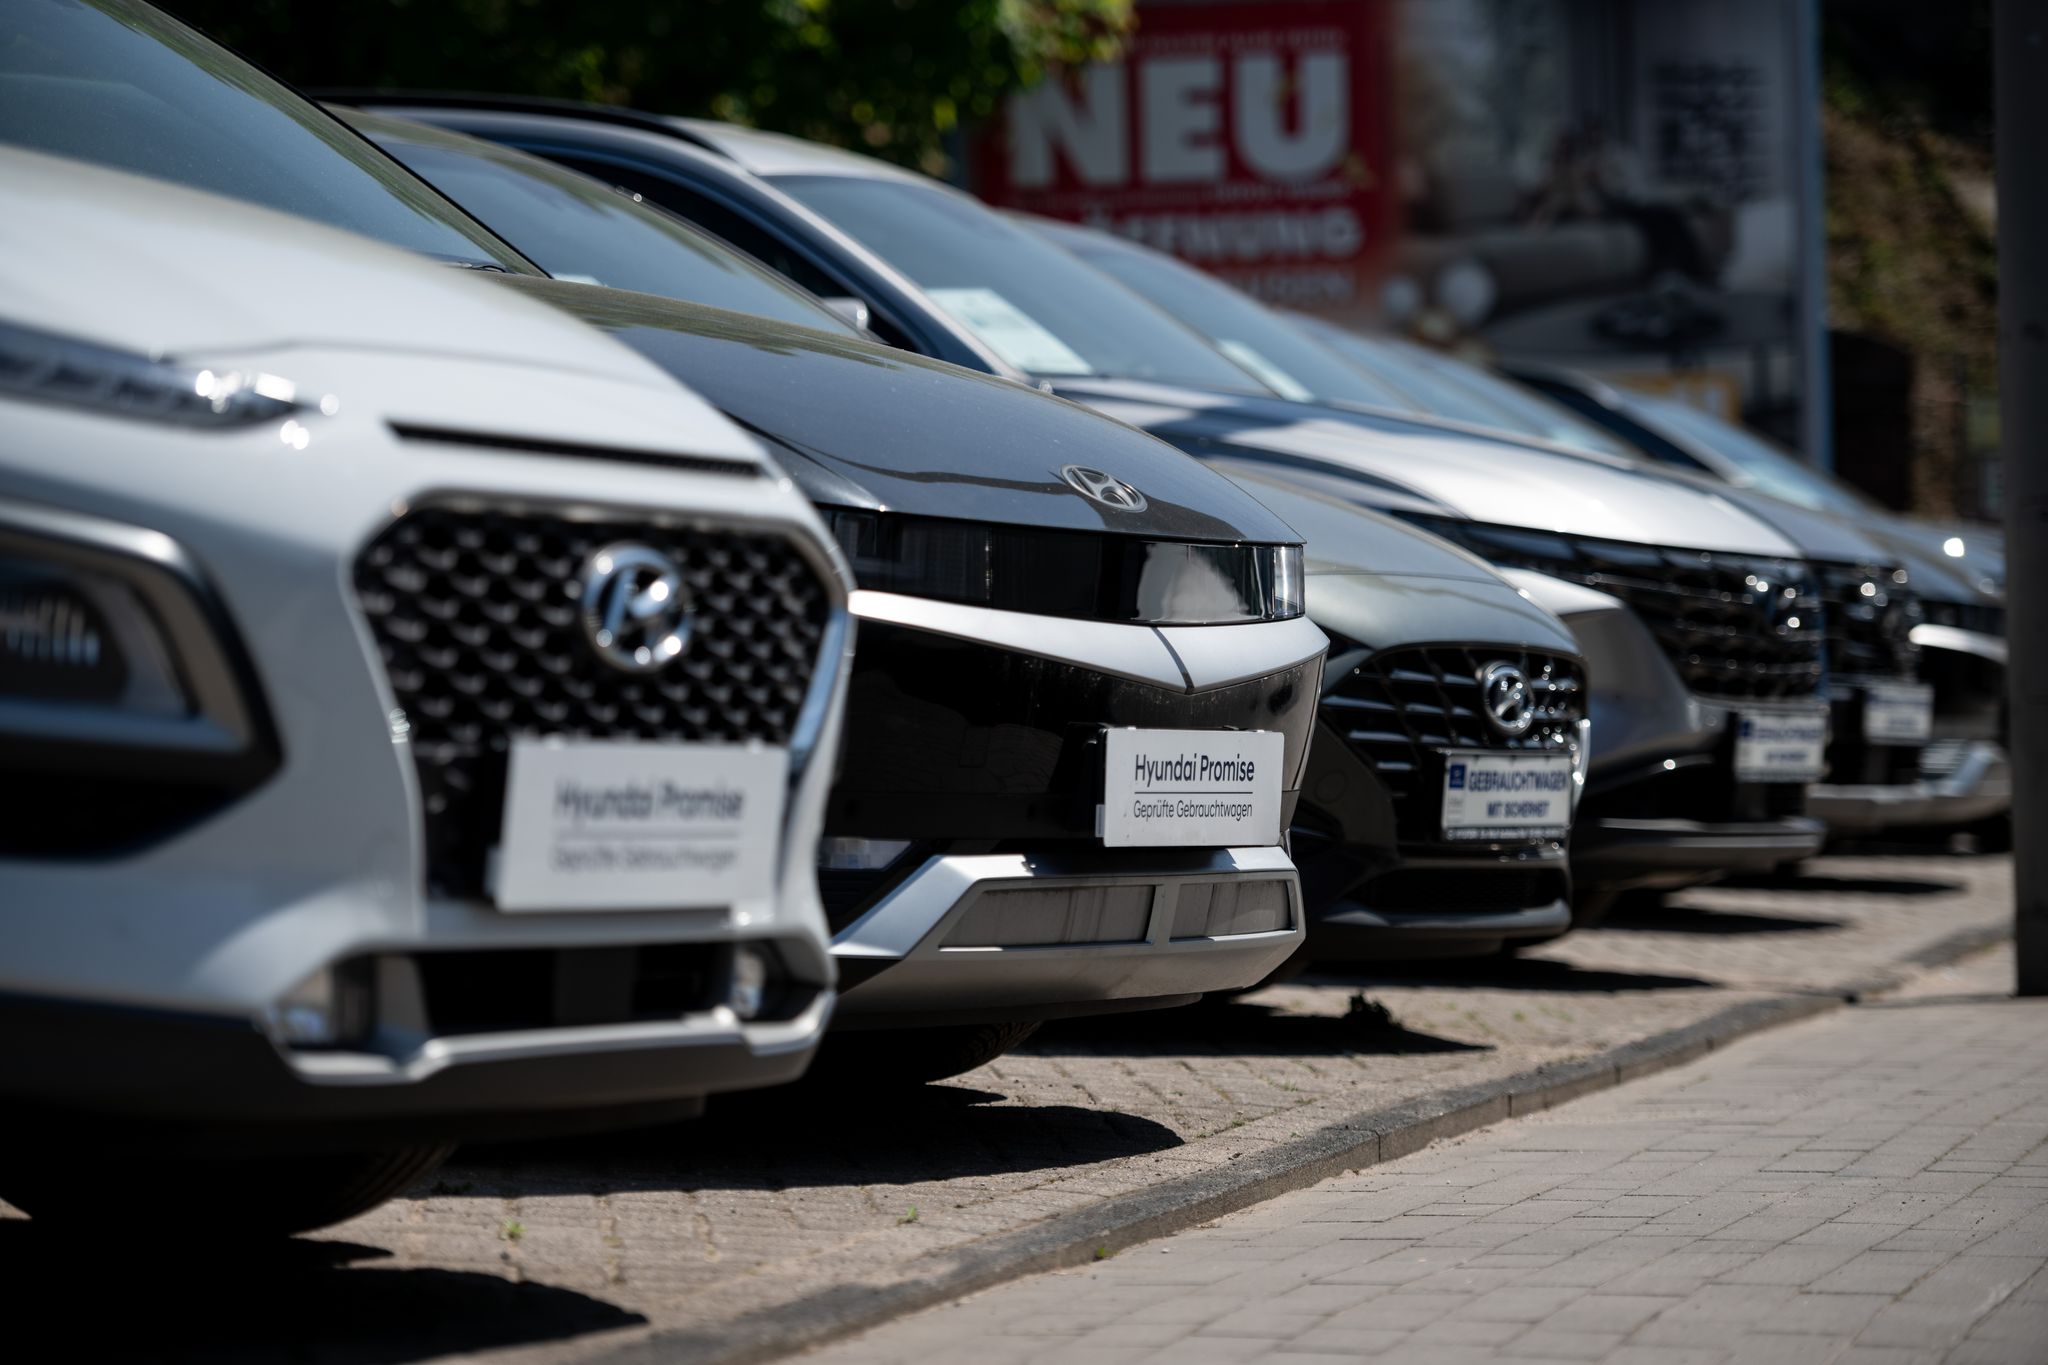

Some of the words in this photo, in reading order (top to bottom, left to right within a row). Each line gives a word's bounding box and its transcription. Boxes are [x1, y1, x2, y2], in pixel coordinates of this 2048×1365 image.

[1007, 51, 1349, 186] NEU
[1134, 753, 1197, 787] Hyundai
[1200, 753, 1255, 782] Promise
[1468, 770, 1568, 793] GEBRAUCHTWAGEN
[555, 777, 652, 828] Hyundai
[656, 778, 744, 820] Promise
[1133, 800, 1175, 822] Geprüfte
[1176, 800, 1253, 822] Gebrauchtwagen
